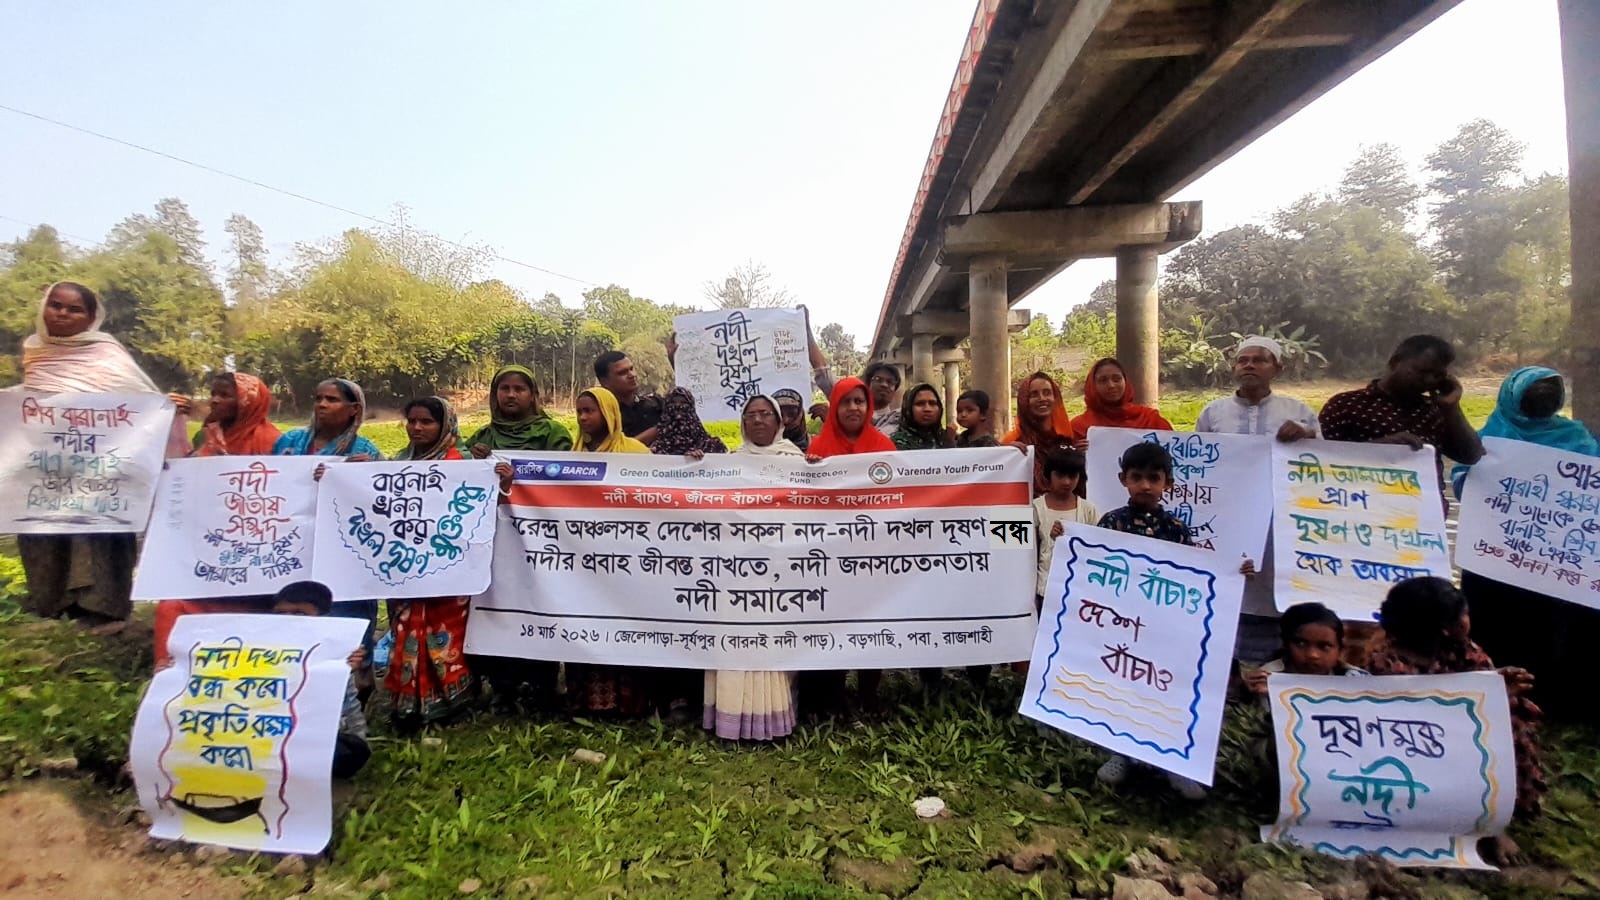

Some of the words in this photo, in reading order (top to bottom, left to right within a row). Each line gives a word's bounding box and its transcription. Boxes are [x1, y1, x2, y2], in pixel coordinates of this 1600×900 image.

[705, 311, 752, 345] নদী
[711, 337, 761, 366] দখল
[714, 363, 758, 390] দূষণ
[42, 426, 105, 454] নদীর
[218, 462, 280, 492] নদী
[516, 462, 544, 475] বারসিক
[562, 466, 598, 476] BARCIK
[619, 467, 649, 478] Green
[651, 467, 741, 479] Coalition-Rajshahi
[897, 466, 942, 477] Varendra
[944, 465, 970, 475] Youth
[972, 463, 1004, 473] Forum
[1287, 453, 1325, 484] নদী
[1330, 464, 1421, 491] আমাদের
[603, 488, 627, 504] নদী
[684, 488, 724, 504] জীবন
[788, 490, 830, 505] বাঁচাও
[835, 493, 904, 506] বাংলাদেশ
[565, 520, 650, 541] অঞ্চলসহ
[657, 519, 721, 542] দেশের
[730, 521, 785, 543] সকল
[793, 514, 876, 544] নদ-নদী
[885, 518, 934, 544] দখল
[941, 517, 987, 546] দূষণ
[1354, 523, 1373, 547] ও
[525, 545, 576, 572] নদীর
[582, 551, 632, 576] প্রবাহ
[638, 547, 694, 577] জীবন্ত
[788, 549, 831, 578] নদী
[837, 552, 990, 575] জনসচেতনতায়
[1295, 550, 1343, 576] হোক
[674, 580, 720, 612] নদী
[728, 586, 829, 613] সমাবেশ
[1086, 555, 1131, 597] নদী
[1138, 567, 1203, 614] বাঁচাও
[1079, 598, 1147, 643] দেশ
[520, 624, 534, 637] ১৪
[538, 623, 557, 639] মার্চ
[561, 628, 600, 642] ২০২৬
[720, 633, 769, 652] (বারনই
[774, 631, 798, 648] নদী
[943, 625, 993, 645] রাজশাহী
[194, 636, 244, 670] নদী
[246, 647, 304, 668] দখল
[1101, 643, 1173, 692] বাঁচাও
[1327, 756, 1430, 817] নদী
